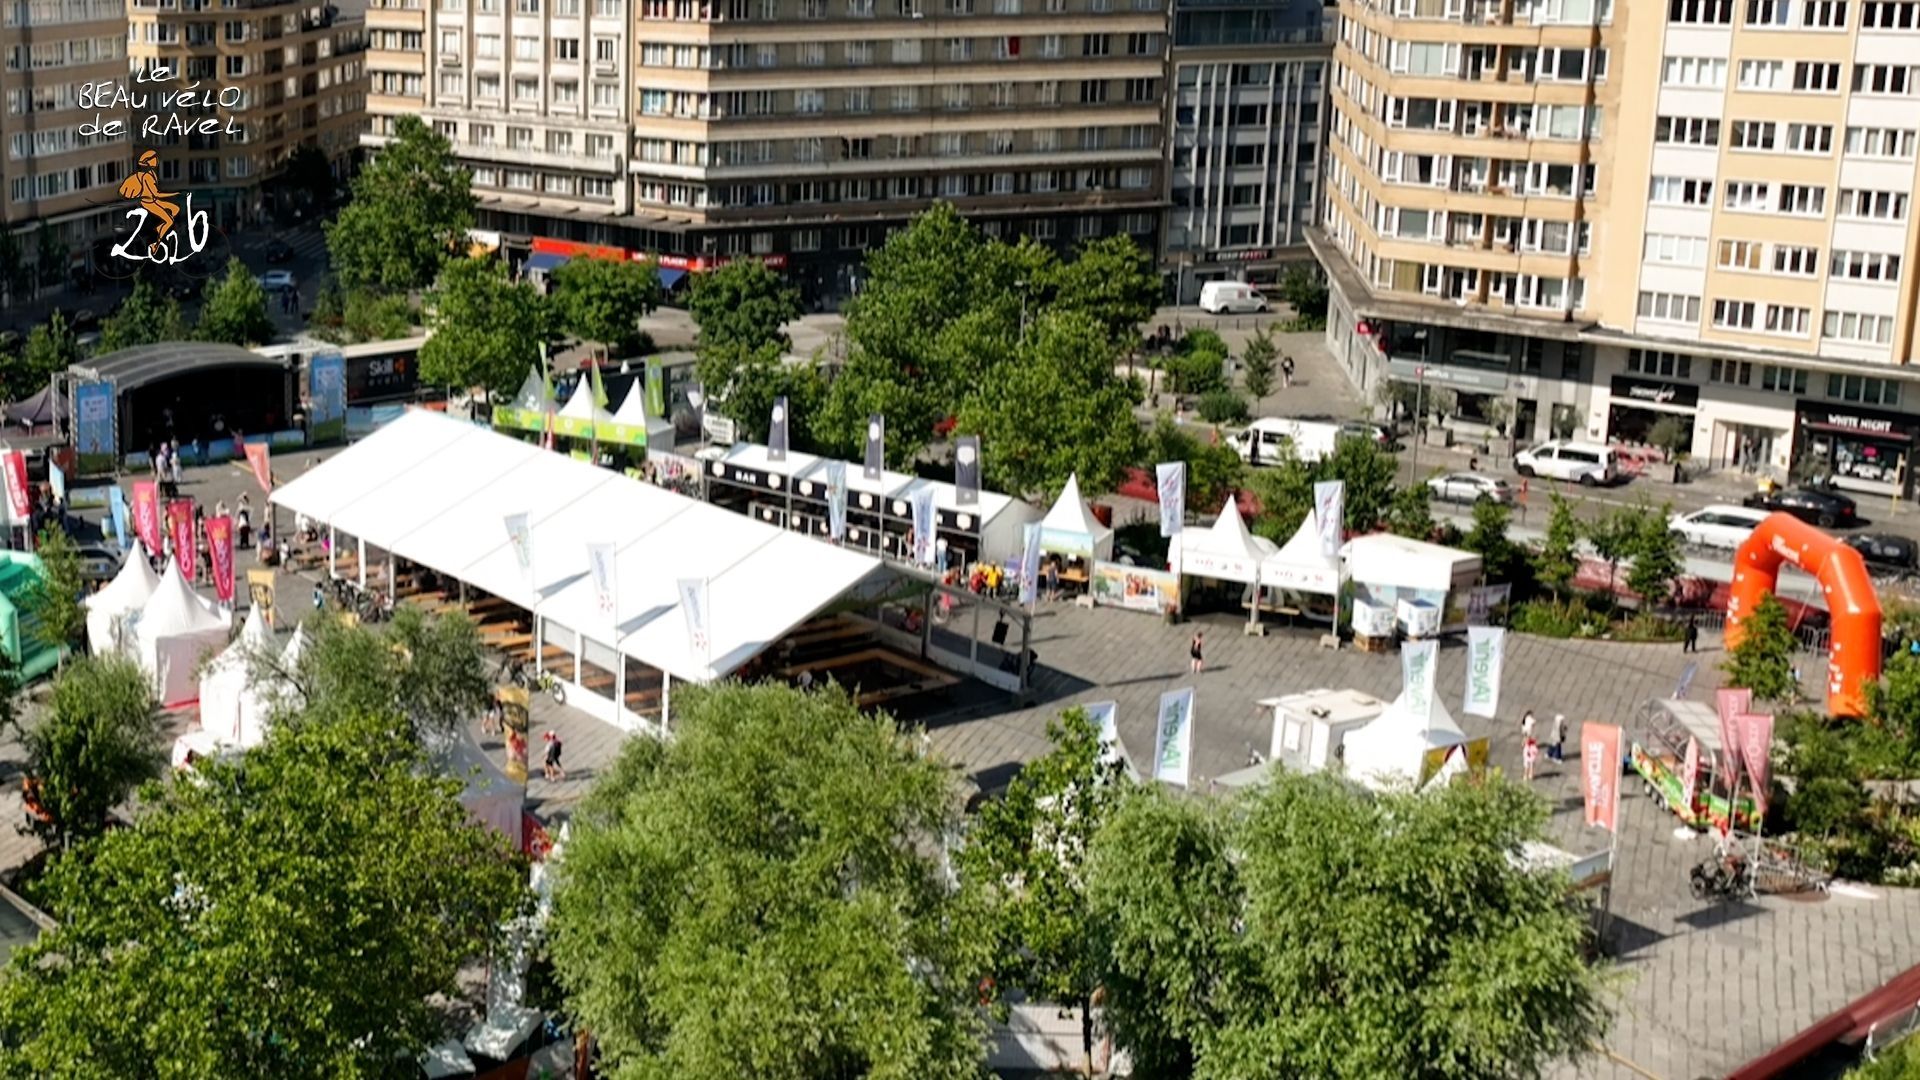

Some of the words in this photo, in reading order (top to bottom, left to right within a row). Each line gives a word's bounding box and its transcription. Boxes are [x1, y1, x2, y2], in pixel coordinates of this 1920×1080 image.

[368, 358, 394, 377] Skill
[1827, 413, 1859, 429] WHITE
[1860, 418, 1892, 433] NIGHT
[735, 470, 757, 485] BAR
